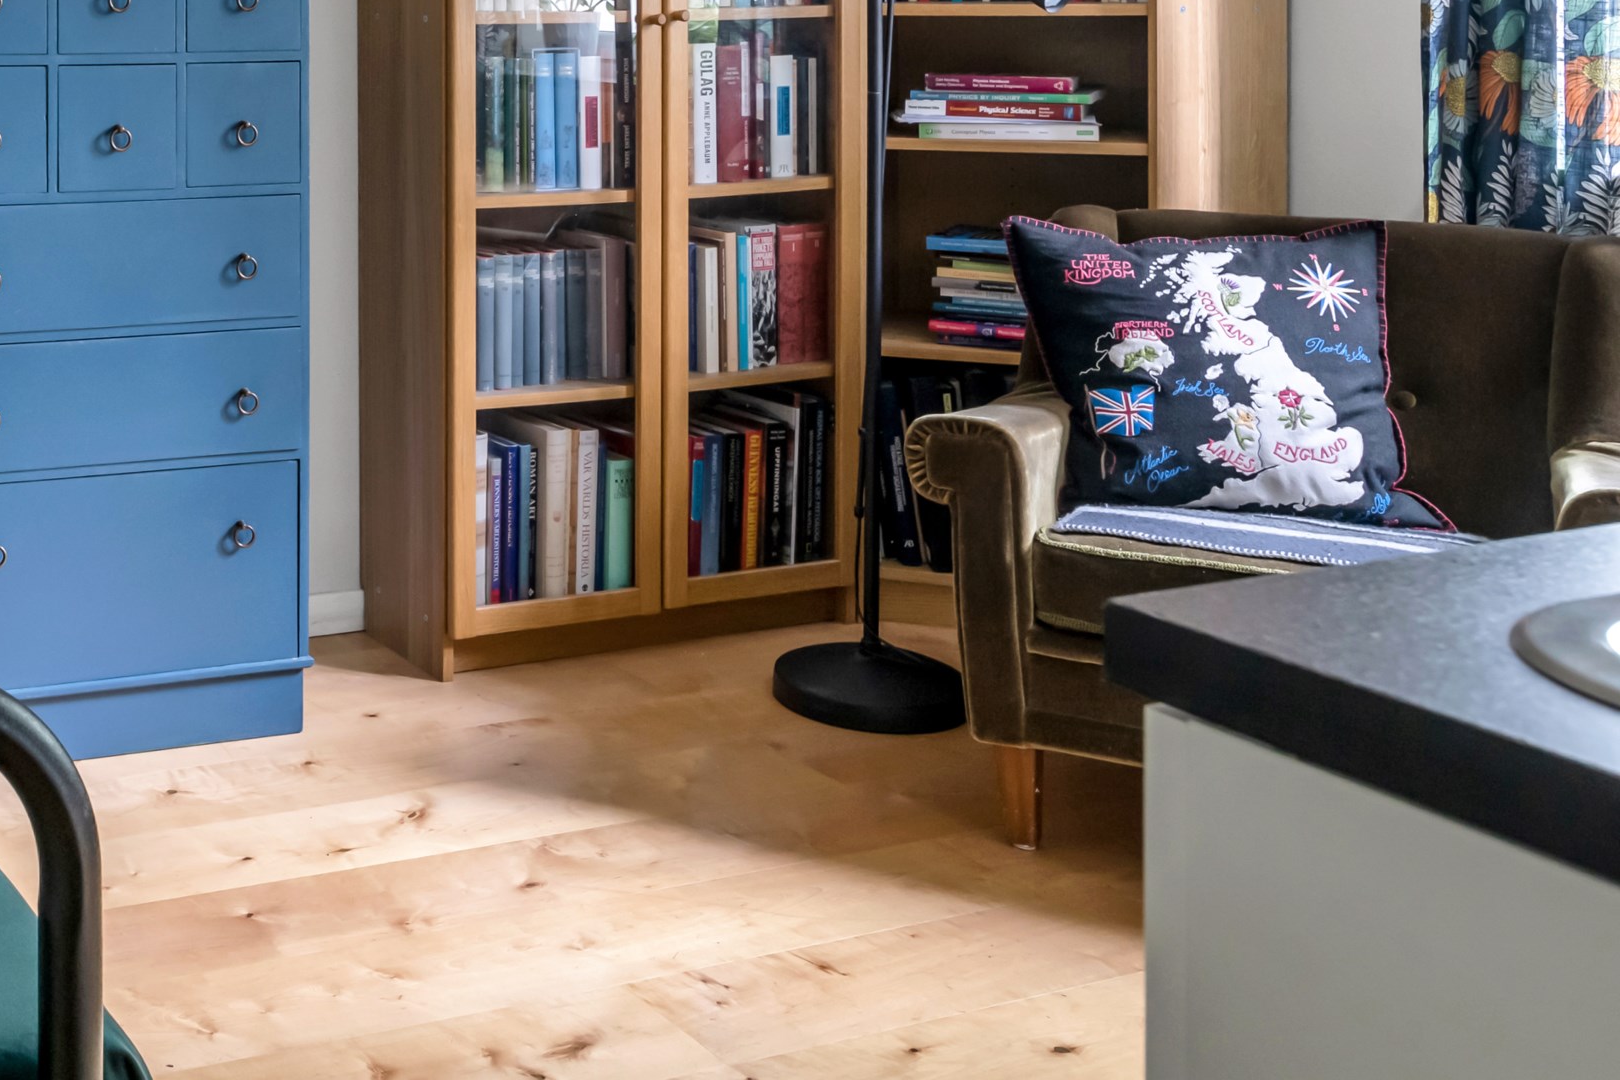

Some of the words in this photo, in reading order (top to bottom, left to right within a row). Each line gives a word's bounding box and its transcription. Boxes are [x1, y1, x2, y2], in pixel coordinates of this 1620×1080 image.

[700, 50, 714, 96] GULAG
[703, 101, 711, 120] ANNE
[978, 105, 1009, 115] Physical
[1010, 107, 1037, 115] Science
[703, 122, 711, 164] APPLEBAUM
[1071, 260, 1132, 269] UNITED
[1083, 253, 1110, 261] THE
[1063, 269, 1136, 285] KINGDOM
[1114, 320, 1168, 328] NORTHERN
[1197, 290, 1254, 347] SCOTLAND
[1115, 327, 1175, 341] IRELAND
[1305, 337, 1348, 357] North
[1347, 346, 1371, 363] Sea
[1172, 378, 1204, 396] Irish
[1204, 382, 1229, 397] Sea
[747, 434, 760, 494] GUINNESS
[1206, 438, 1257, 473] WALES
[1273, 437, 1347, 464] ENGLAND
[1124, 445, 1178, 485] Atlantic
[772, 446, 781, 513] UPPFINNINGAR
[1146, 465, 1190, 493] Ocean
[581, 524, 590, 579] HISTORIA
